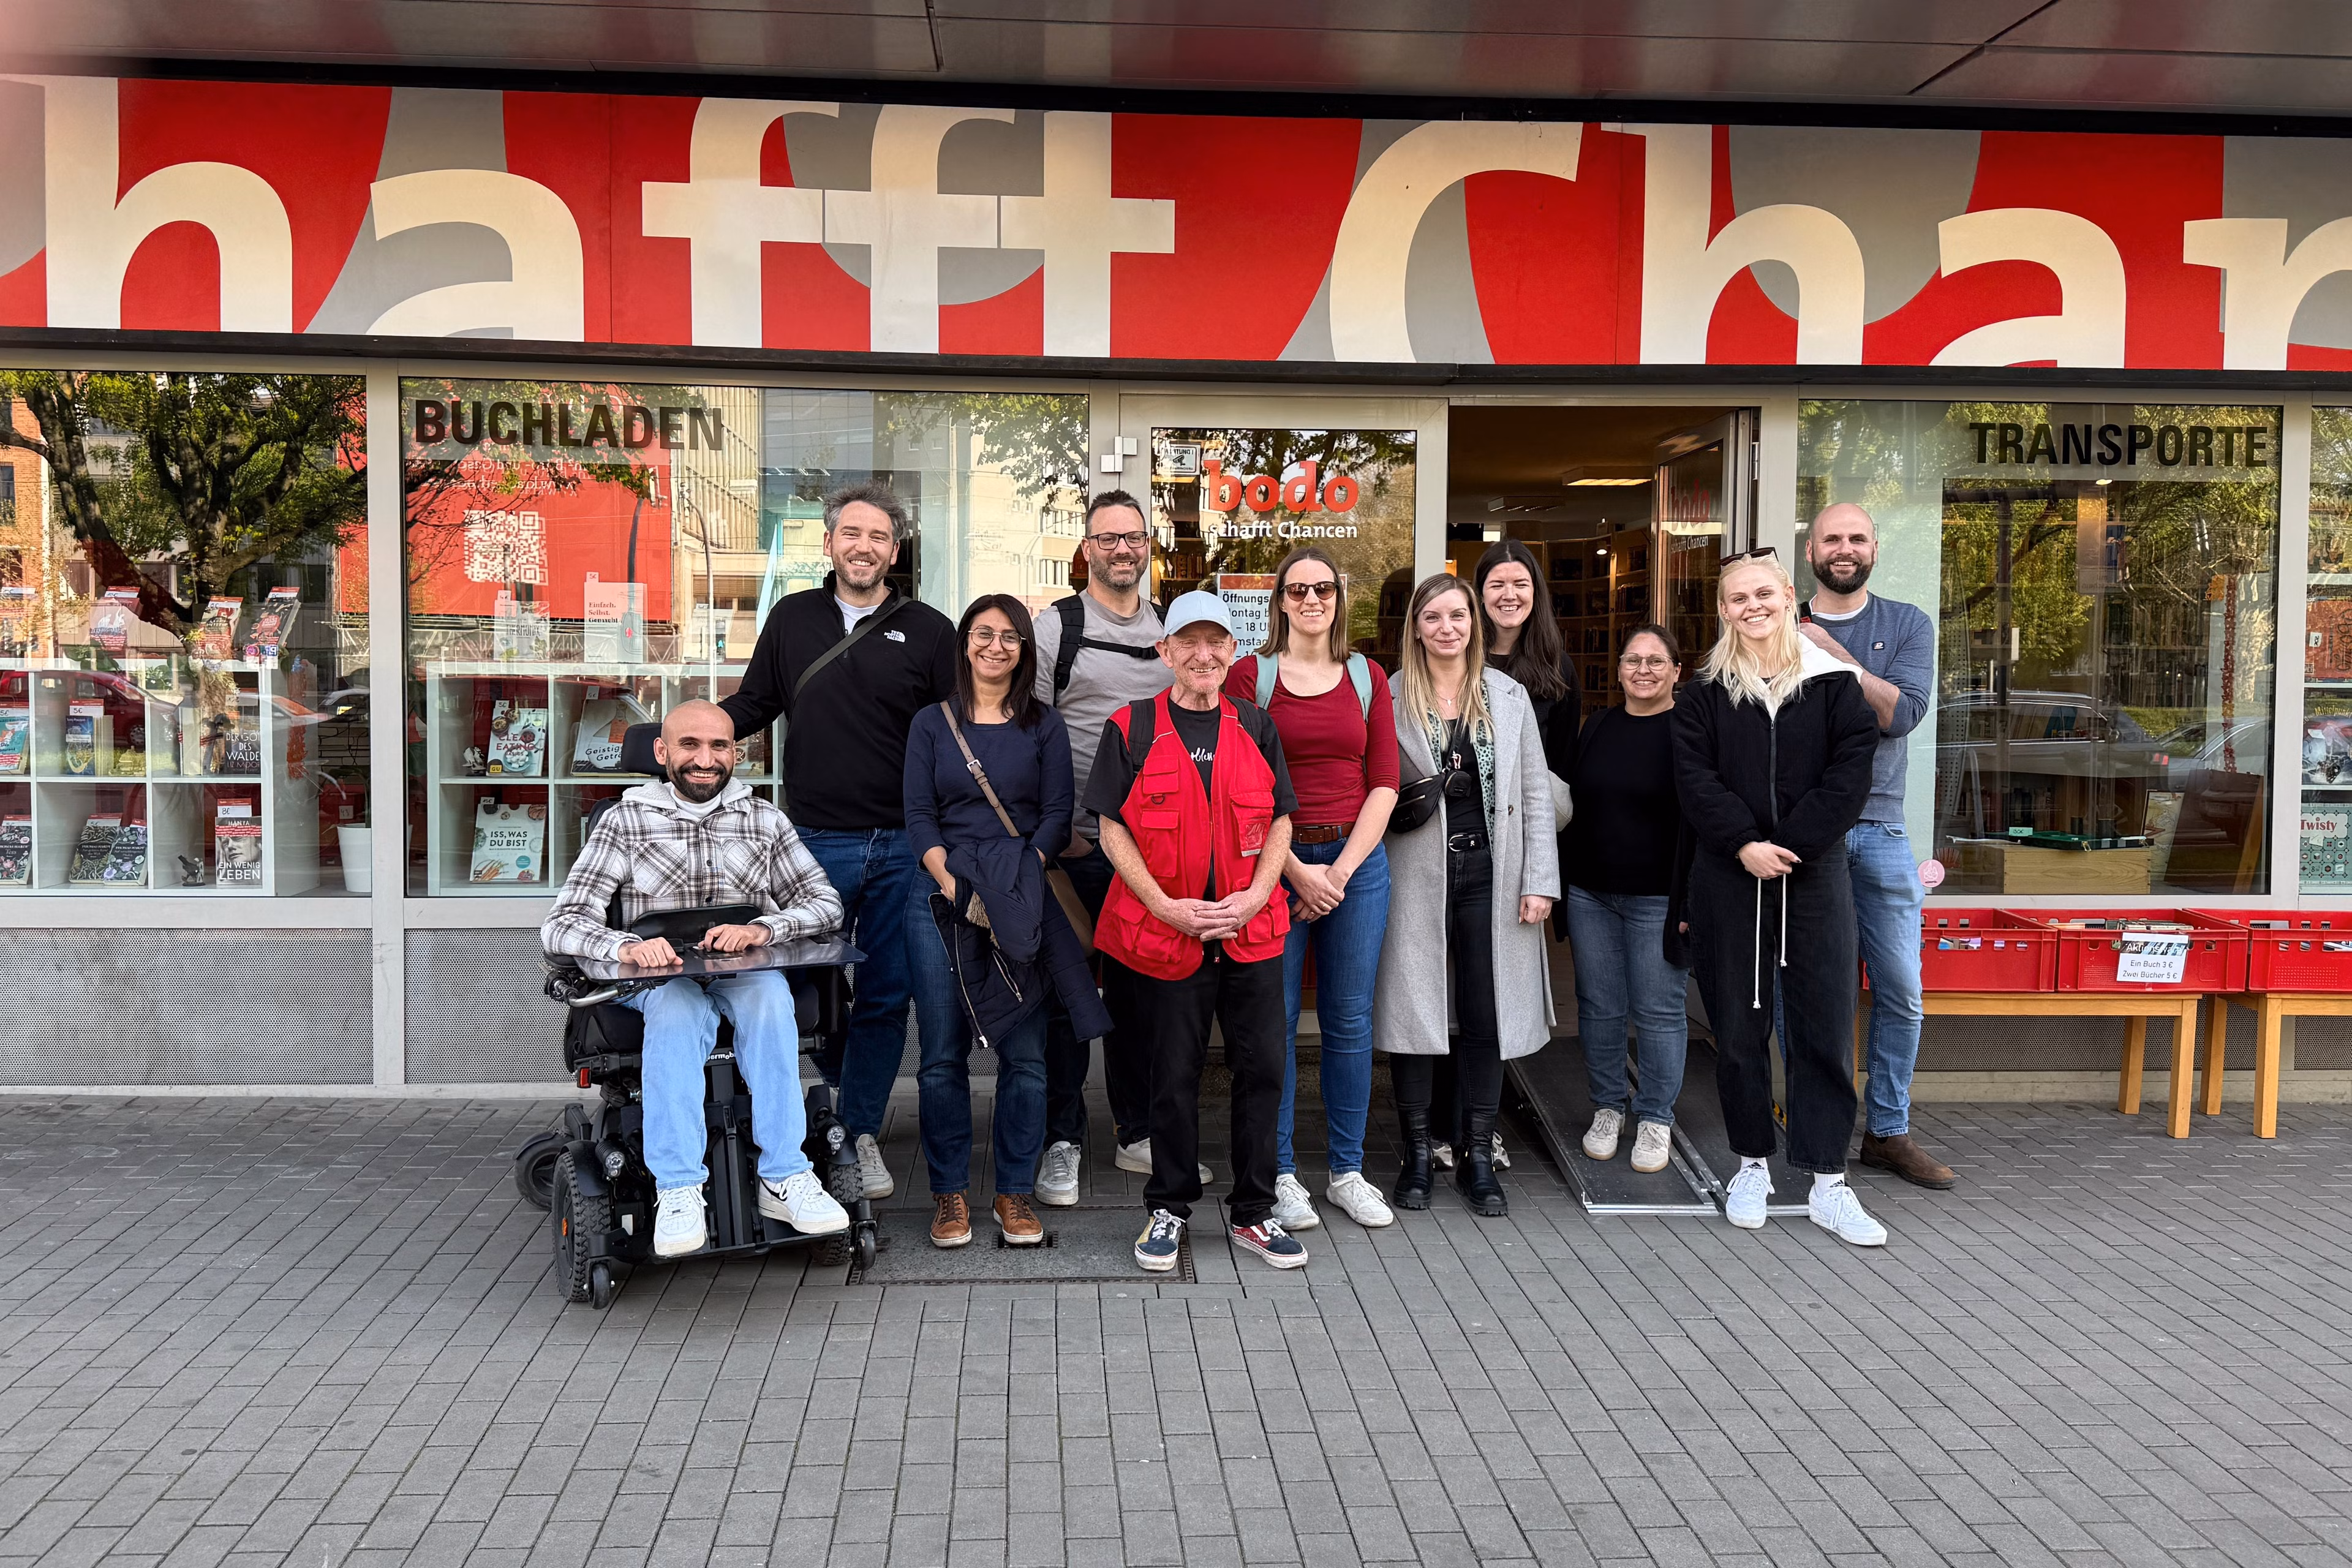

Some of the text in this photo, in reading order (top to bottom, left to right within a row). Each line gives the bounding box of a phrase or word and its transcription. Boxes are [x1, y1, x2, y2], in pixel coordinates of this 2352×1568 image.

[415, 400, 723, 451] BUCHLADEN
[1969, 422, 2268, 468] TRANSPORTE
[1203, 459, 1359, 513] bodo
[1210, 520, 1358, 538] schafft Chancen
[1687, 535, 1708, 550] Chancen
[1223, 591, 1269, 605] Öffnungs
[1245, 622, 1256, 631] 18
[226, 733, 239, 742] DER
[239, 742, 252, 751] DES
[226, 751, 261, 761] WALDE
[2301, 816, 2337, 833] Twisty
[219, 870, 260, 880] LEBEN
